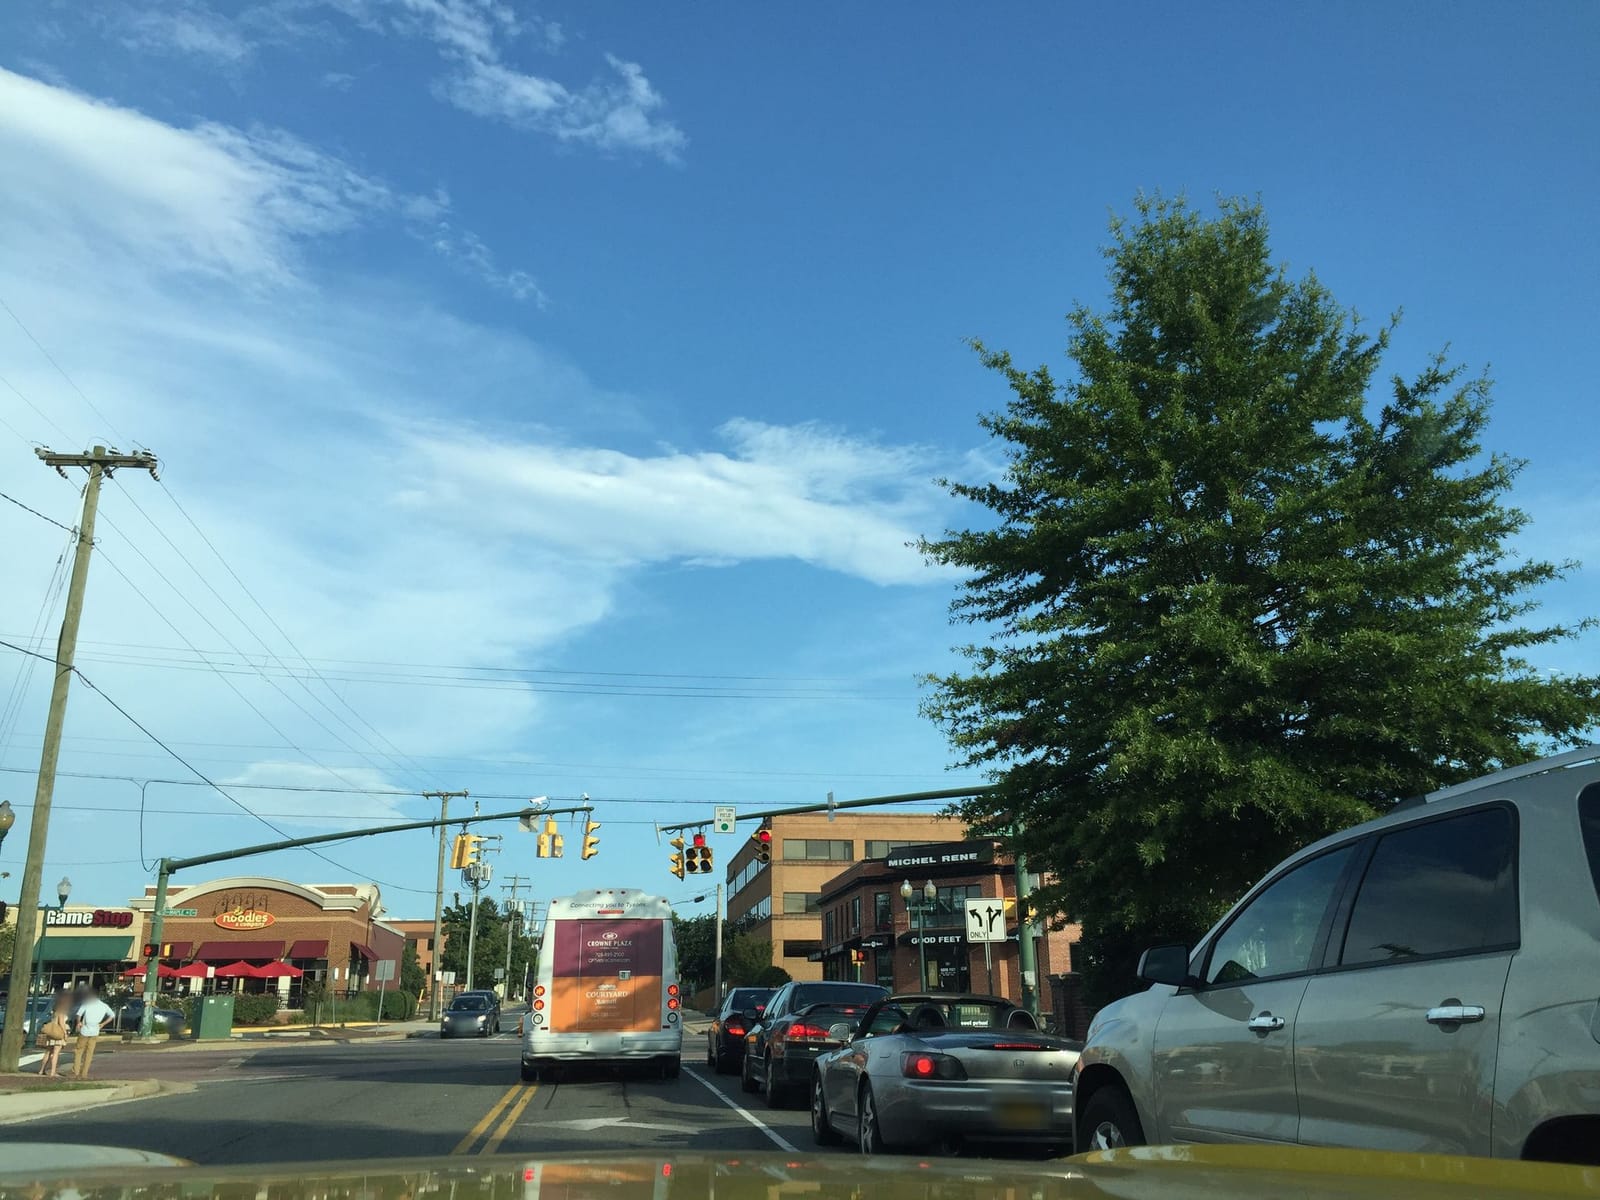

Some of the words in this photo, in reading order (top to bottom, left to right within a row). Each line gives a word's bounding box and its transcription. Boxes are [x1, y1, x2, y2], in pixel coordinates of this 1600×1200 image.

[888, 857, 937, 867] MICHEL
[941, 852, 978, 863] RENE
[46, 909, 133, 928] GameStop
[222, 911, 268, 923] noodles
[938, 935, 961, 943] FEET
[970, 931, 987, 939] ONLY
